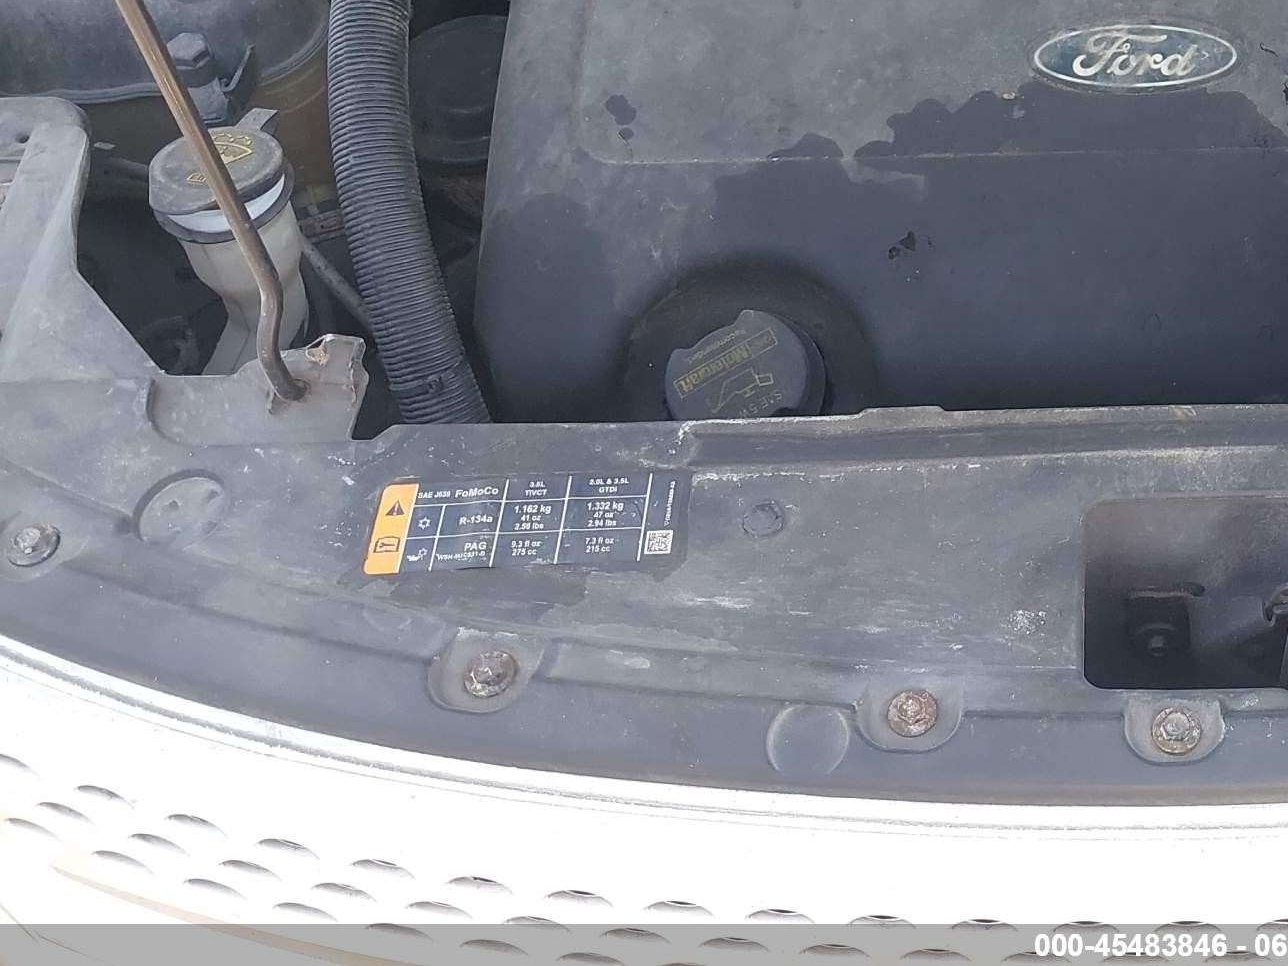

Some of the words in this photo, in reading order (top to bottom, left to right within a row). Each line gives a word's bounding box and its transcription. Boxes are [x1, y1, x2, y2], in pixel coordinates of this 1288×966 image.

[1072, 34, 1198, 76] Ford
[455, 487, 499, 498] FoMoCo
[514, 505, 538, 514] 1.162
[540, 505, 552, 514] kg
[587, 502, 611, 511] 1.332
[612, 501, 624, 511] kg
[459, 514, 493, 525] R-134a
[464, 542, 487, 551] PAG
